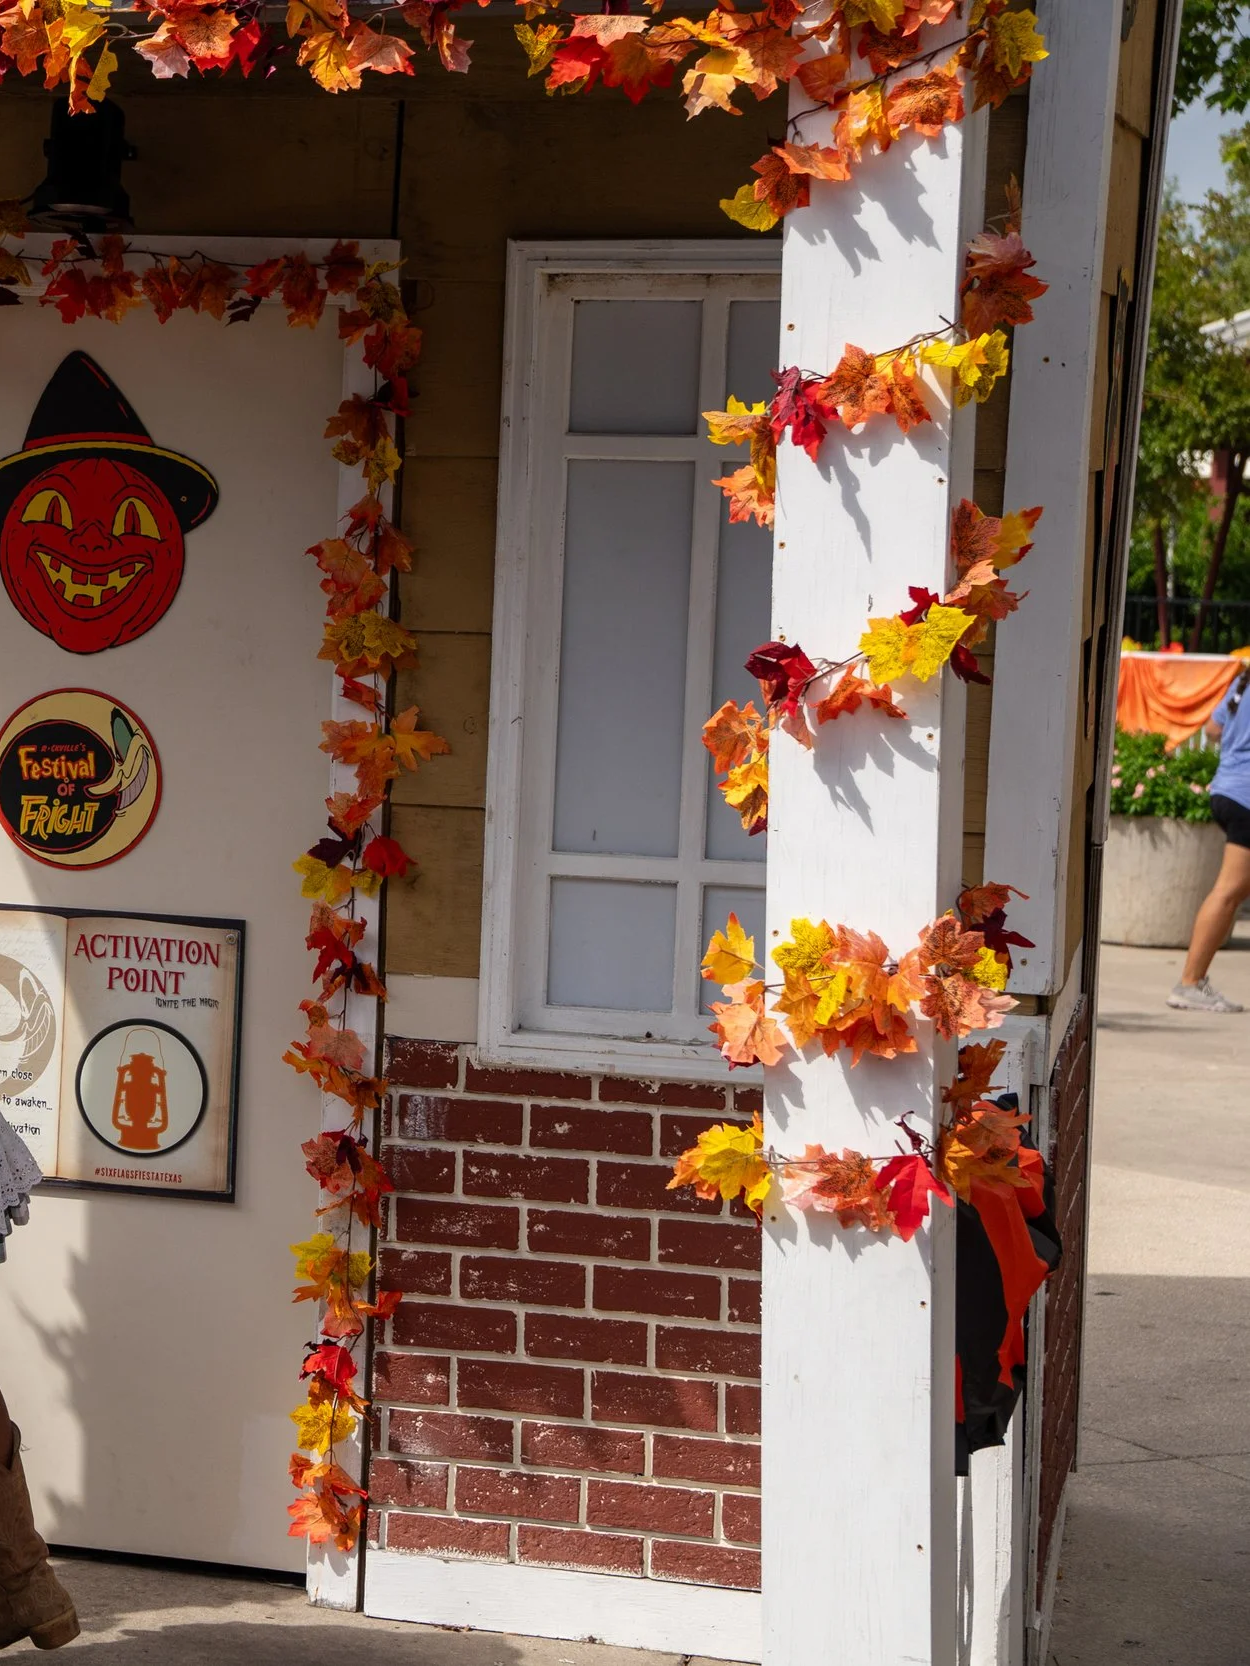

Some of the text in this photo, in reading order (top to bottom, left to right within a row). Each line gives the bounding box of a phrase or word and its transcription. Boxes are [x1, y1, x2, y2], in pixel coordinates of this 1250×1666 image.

[18, 745, 95, 780] Festival
[57, 783, 75, 797] OF
[73, 933, 221, 968] ACTIVATION
[106, 966, 185, 996] POINT
[181, 998, 196, 1008] THE
[11, 1068, 33, 1080] close
[2, 1094, 12, 1105] to
[94, 1167, 183, 1184] #SIXFLAGSFIESTATEXAS
